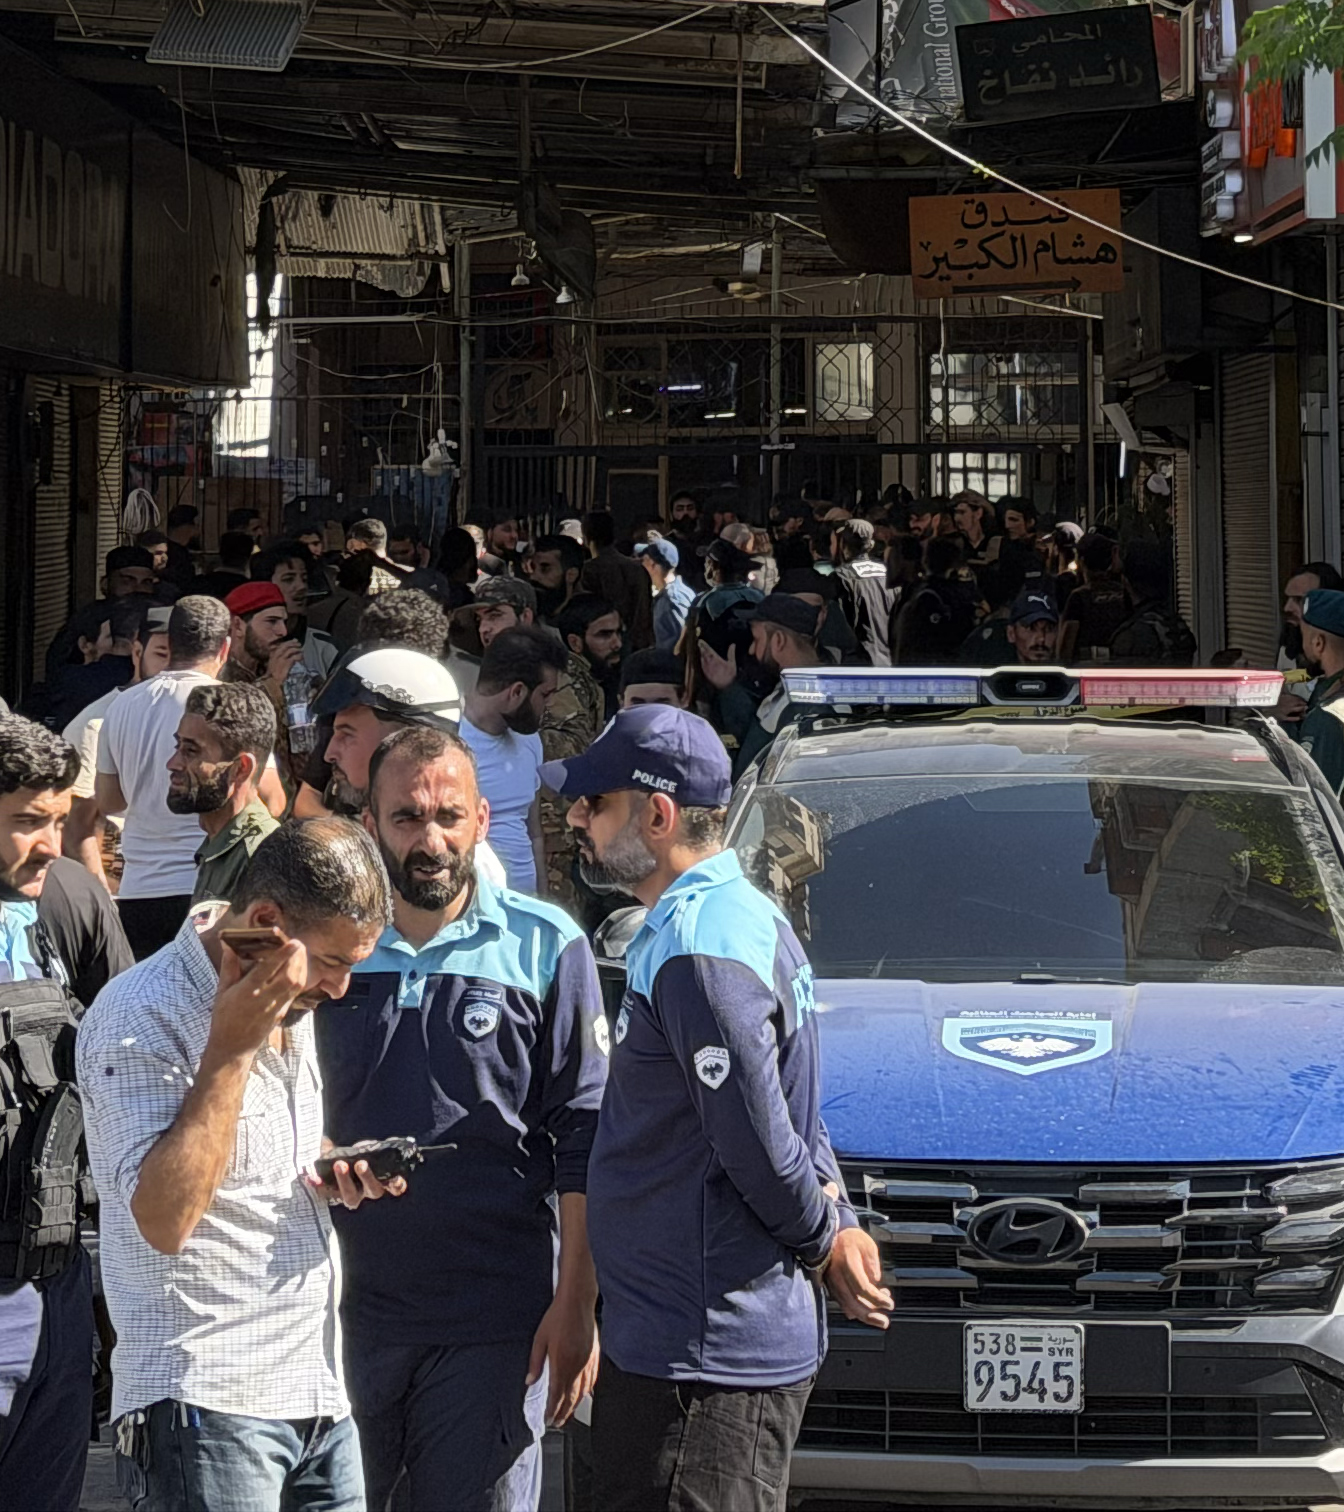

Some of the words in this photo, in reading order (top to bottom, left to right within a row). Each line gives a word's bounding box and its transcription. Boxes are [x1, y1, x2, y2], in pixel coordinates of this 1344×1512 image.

[1011, 23, 1102, 57] المحامي
[960, 196, 1071, 230] فندق
[917, 229, 1027, 282] الكبير
[1033, 231, 1118, 276] هشام
[631, 768, 678, 794] POLICE
[973, 1332, 1017, 1356] 538
[1047, 1346, 1075, 1358] SYR
[973, 1359, 1075, 1404] 9545
